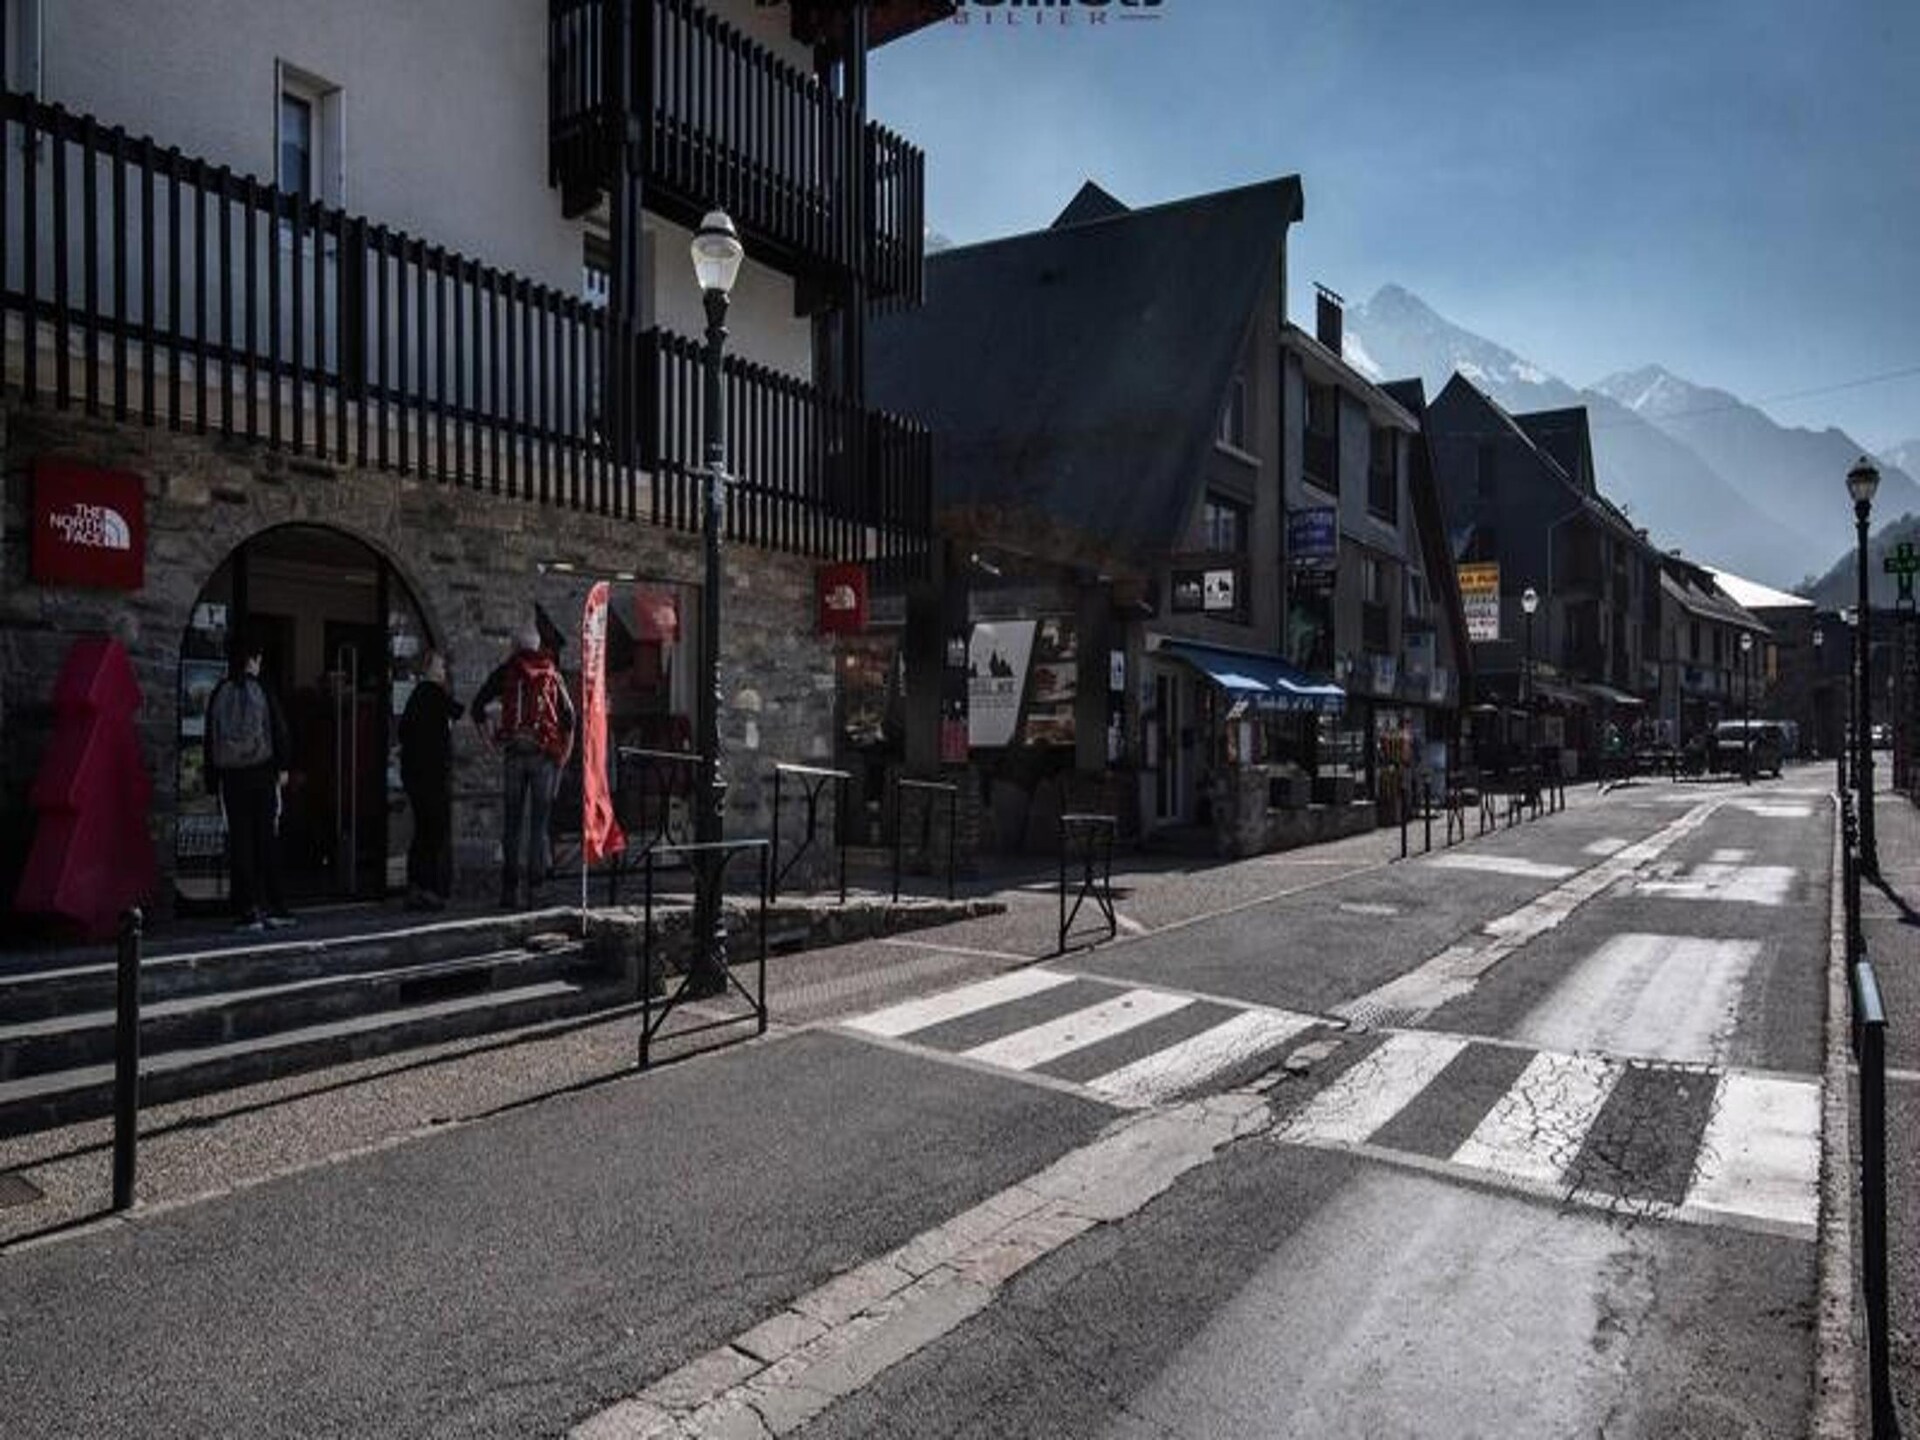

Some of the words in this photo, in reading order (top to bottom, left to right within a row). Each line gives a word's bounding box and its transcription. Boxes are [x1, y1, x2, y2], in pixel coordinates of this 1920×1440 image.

[75, 503, 101, 518] THE
[50, 513, 103, 533] NORTH
[64, 528, 103, 547] FACE
